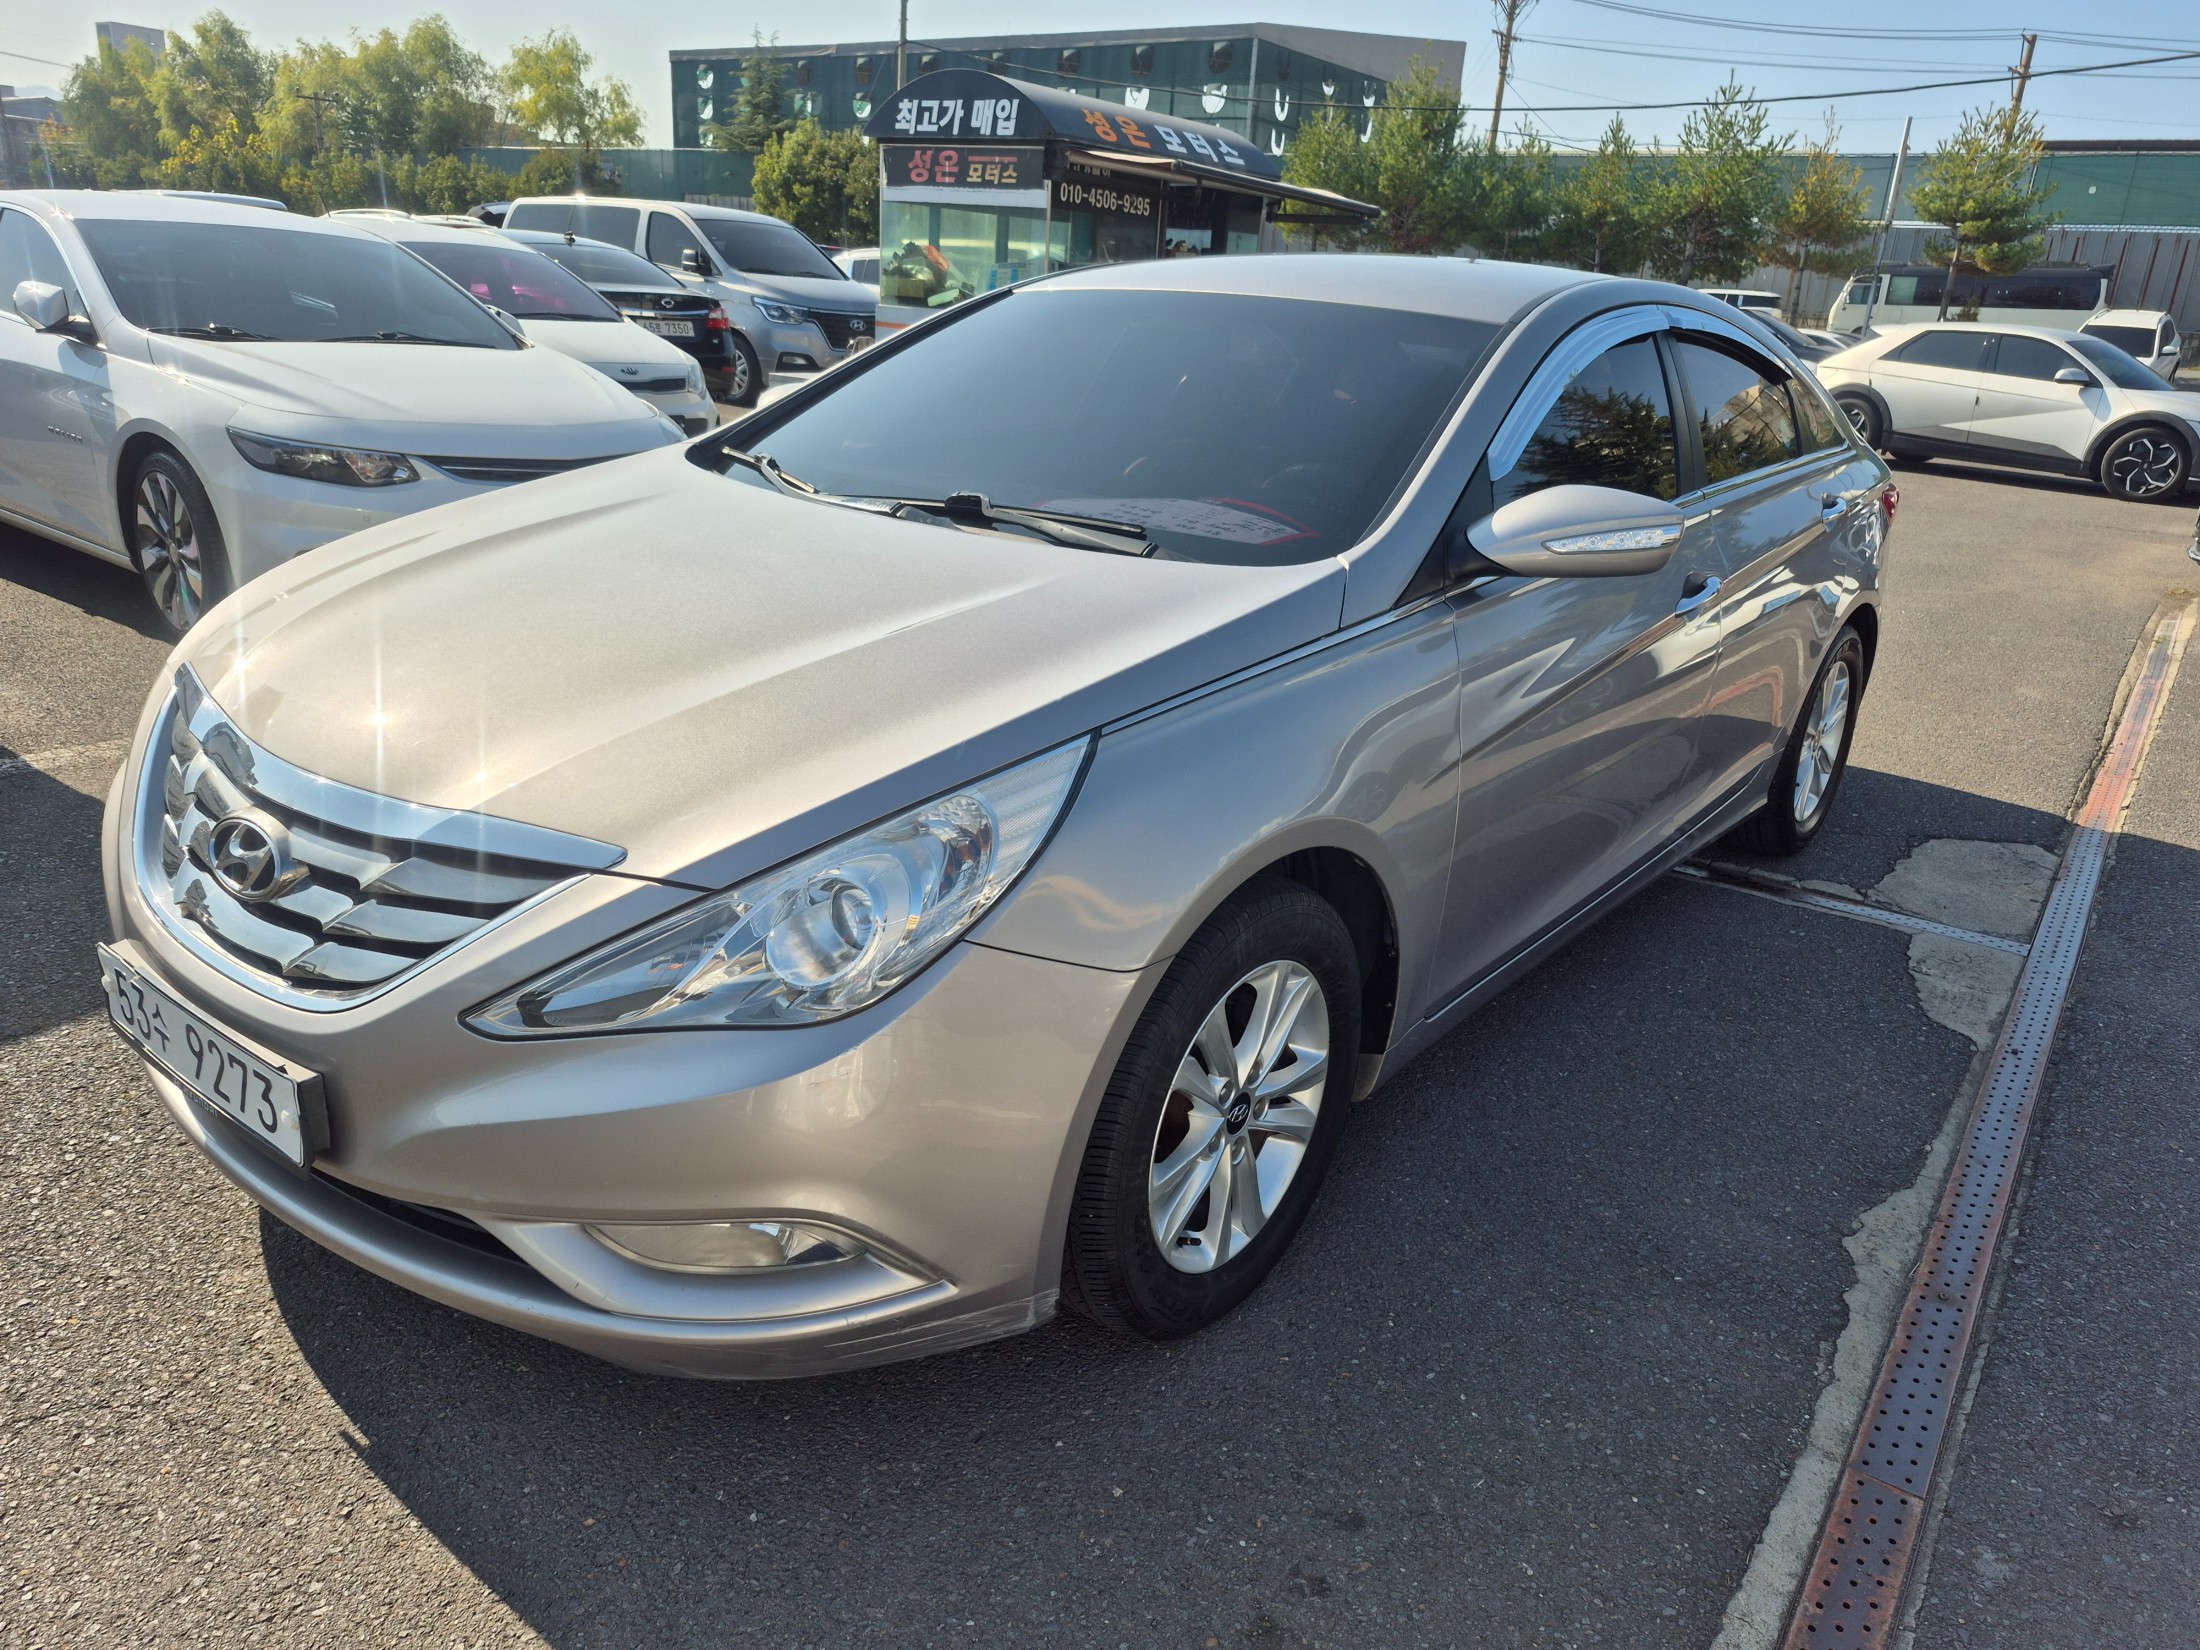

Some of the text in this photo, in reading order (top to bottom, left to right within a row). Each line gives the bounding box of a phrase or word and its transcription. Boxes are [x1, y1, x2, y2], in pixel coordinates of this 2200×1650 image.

[895, 99, 1019, 135] 최고가 매입
[1081, 108, 1245, 165] 성은 모터스
[908, 150, 1018, 184] 성은 모터스
[1060, 182, 1150, 216] 010-4506-9295
[665, 322, 689, 334] 7350
[114, 968, 279, 1134] 53수 9273
